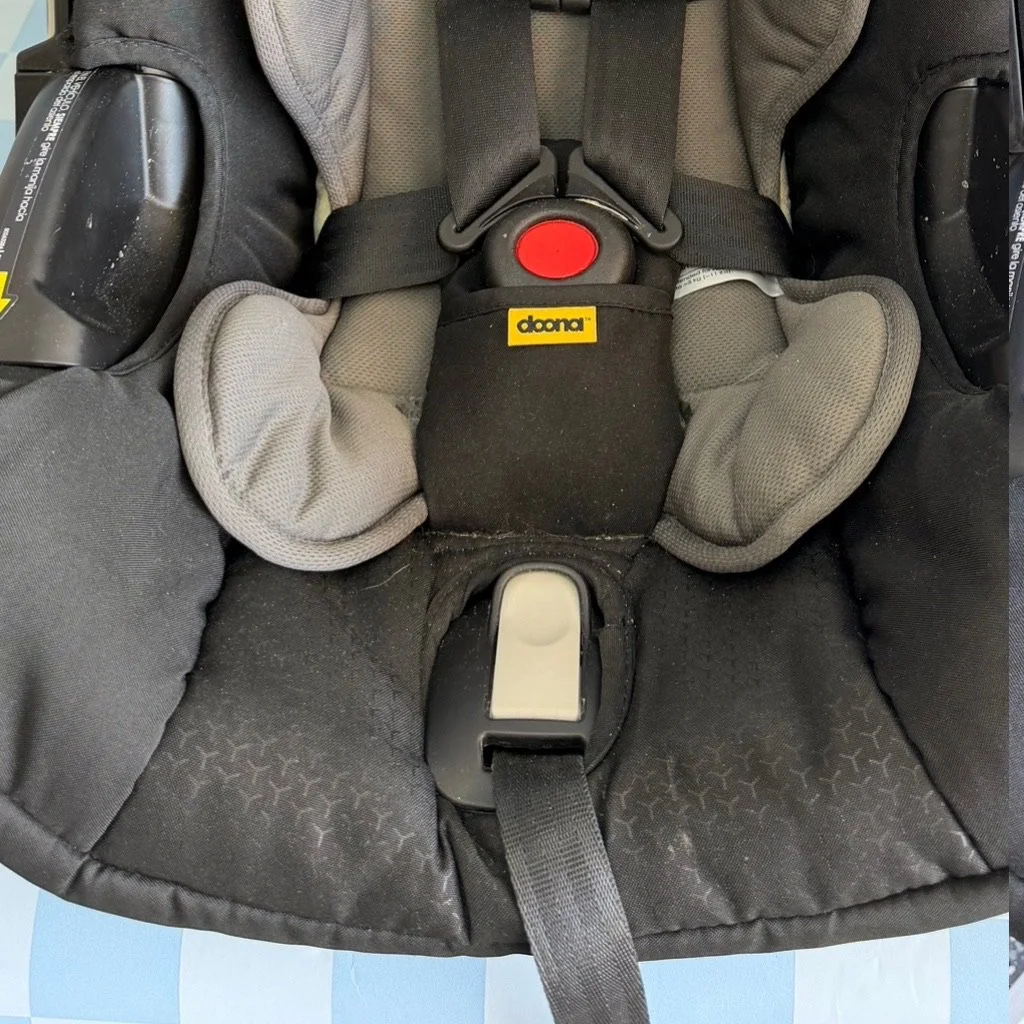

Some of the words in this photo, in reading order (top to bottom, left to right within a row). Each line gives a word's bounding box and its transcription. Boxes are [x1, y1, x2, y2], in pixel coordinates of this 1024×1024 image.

[46, 113, 66, 142] SIEMPRE
[15, 196, 33, 222] hacia
[1011, 243, 1023, 260] gire
[517, 315, 584, 333] doona
